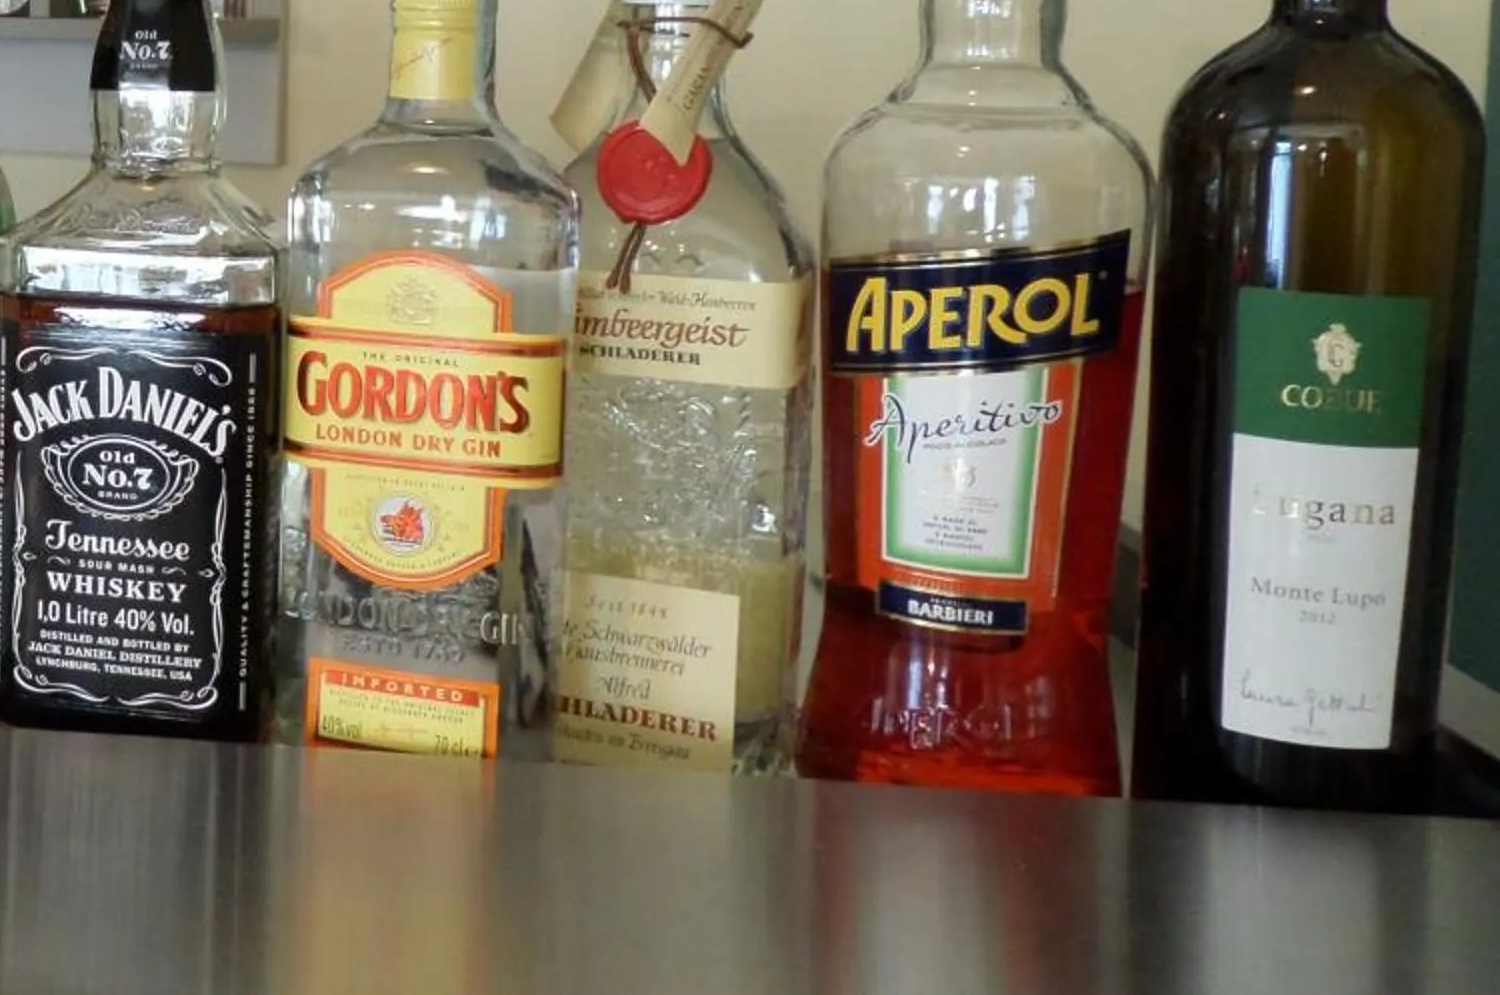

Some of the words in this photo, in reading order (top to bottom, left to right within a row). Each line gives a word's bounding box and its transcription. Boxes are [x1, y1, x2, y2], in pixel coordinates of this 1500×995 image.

[135, 30, 157, 40] Old
[845, 272, 1101, 352] APEROL
[575, 307, 753, 349] imbeergeist
[296, 350, 531, 434] GORDON'S
[11, 380, 94, 442] JACK
[98, 366, 237, 458] DANIEL'S
[316, 423, 403, 448] LONDON
[413, 435, 455, 453] DRY
[462, 439, 501, 458] GIN
[866, 396, 1060, 464] Aperitivo
[100, 450, 136, 464] Old
[82, 462, 154, 490] No.7
[97, 490, 139, 500] BRAND
[45, 518, 191, 561] Tennessee
[78, 558, 113, 571] SOUR
[117, 562, 155, 574] MASH
[46, 571, 188, 603] WHISKEY
[1250, 576, 1324, 603] Monte
[1332, 587, 1386, 613] Lupo
[37, 599, 61, 623] 1,0
[65, 602, 109, 627] Litre
[113, 607, 157, 633] 40%
[160, 611, 195, 636] Vol.
[907, 599, 995, 626] BARBIERI
[1299, 609, 1336, 625] 2012
[28, 641, 62, 655] JACK
[64, 644, 117, 661] DANIEL
[119, 651, 203, 670] DISTILLERY
[39, 629, 93, 645] DISTILLED
[96, 636, 120, 647] AND
[122, 639, 171, 653] BOTTLED
[174, 644, 190, 654] BY
[170, 670, 193, 682] USA
[340, 672, 465, 703] IMPORTED
